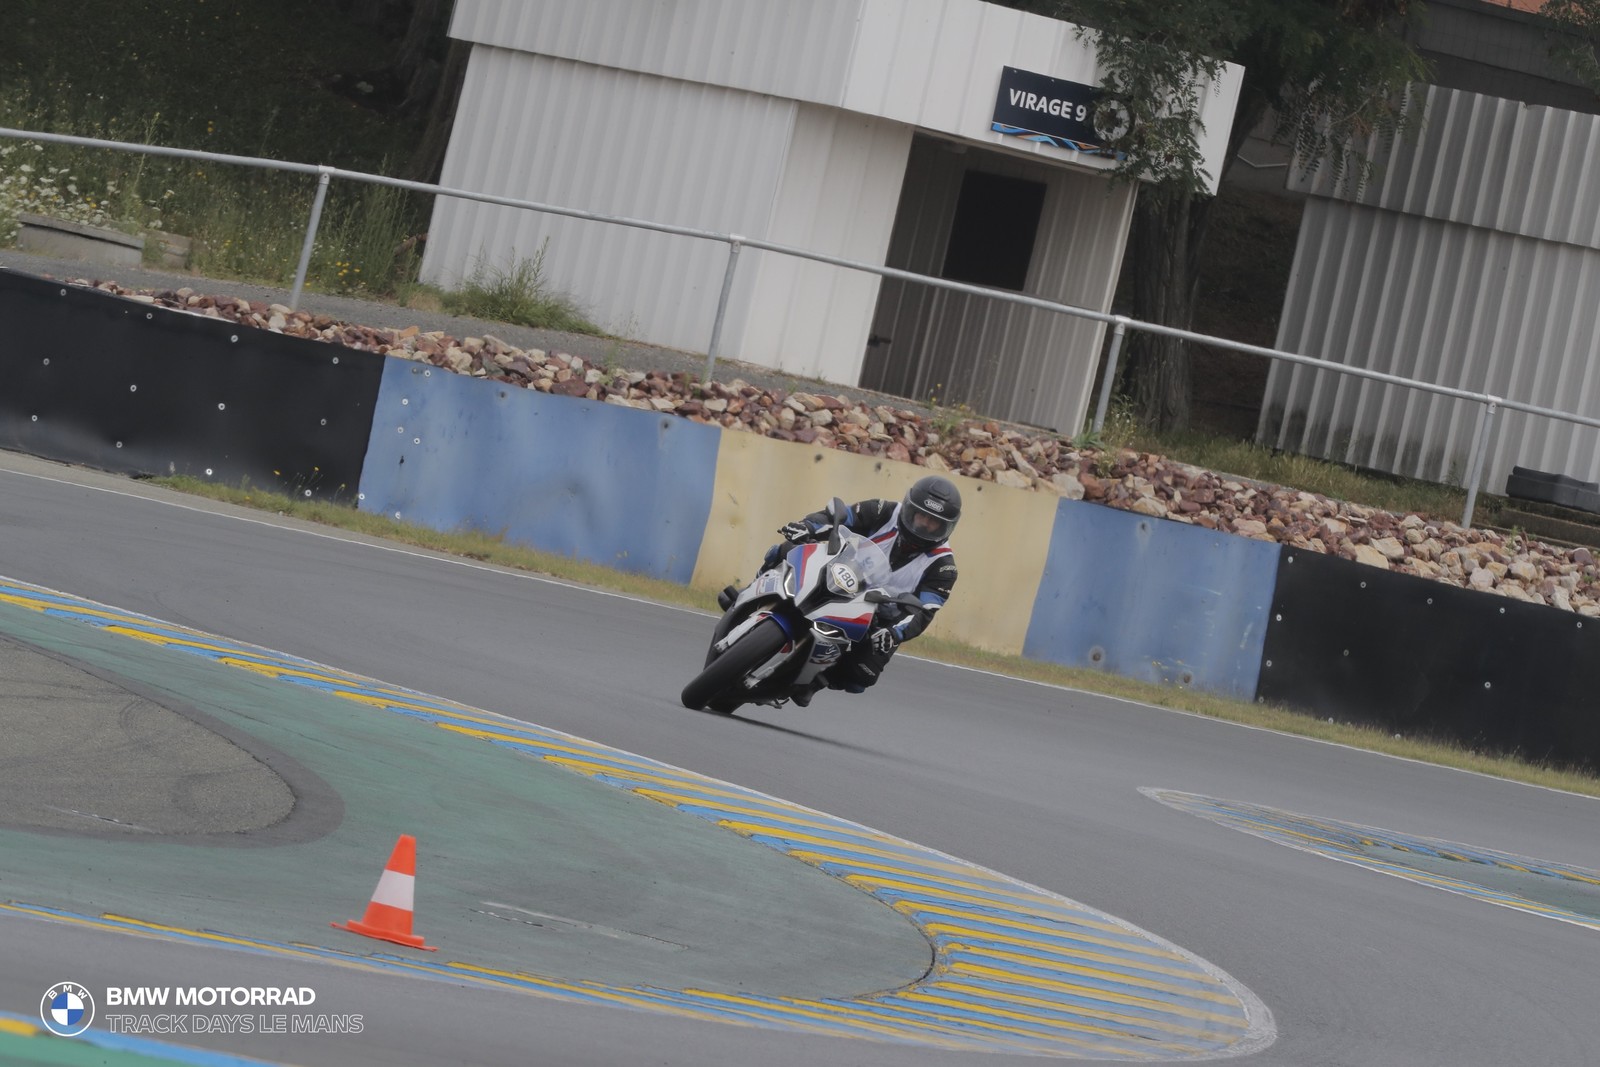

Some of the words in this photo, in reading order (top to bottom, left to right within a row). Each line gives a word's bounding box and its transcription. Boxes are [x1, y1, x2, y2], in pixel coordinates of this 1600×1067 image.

[1009, 87, 1073, 120] VIRAGE
[1075, 104, 1087, 122] 9
[837, 566, 855, 588] 180
